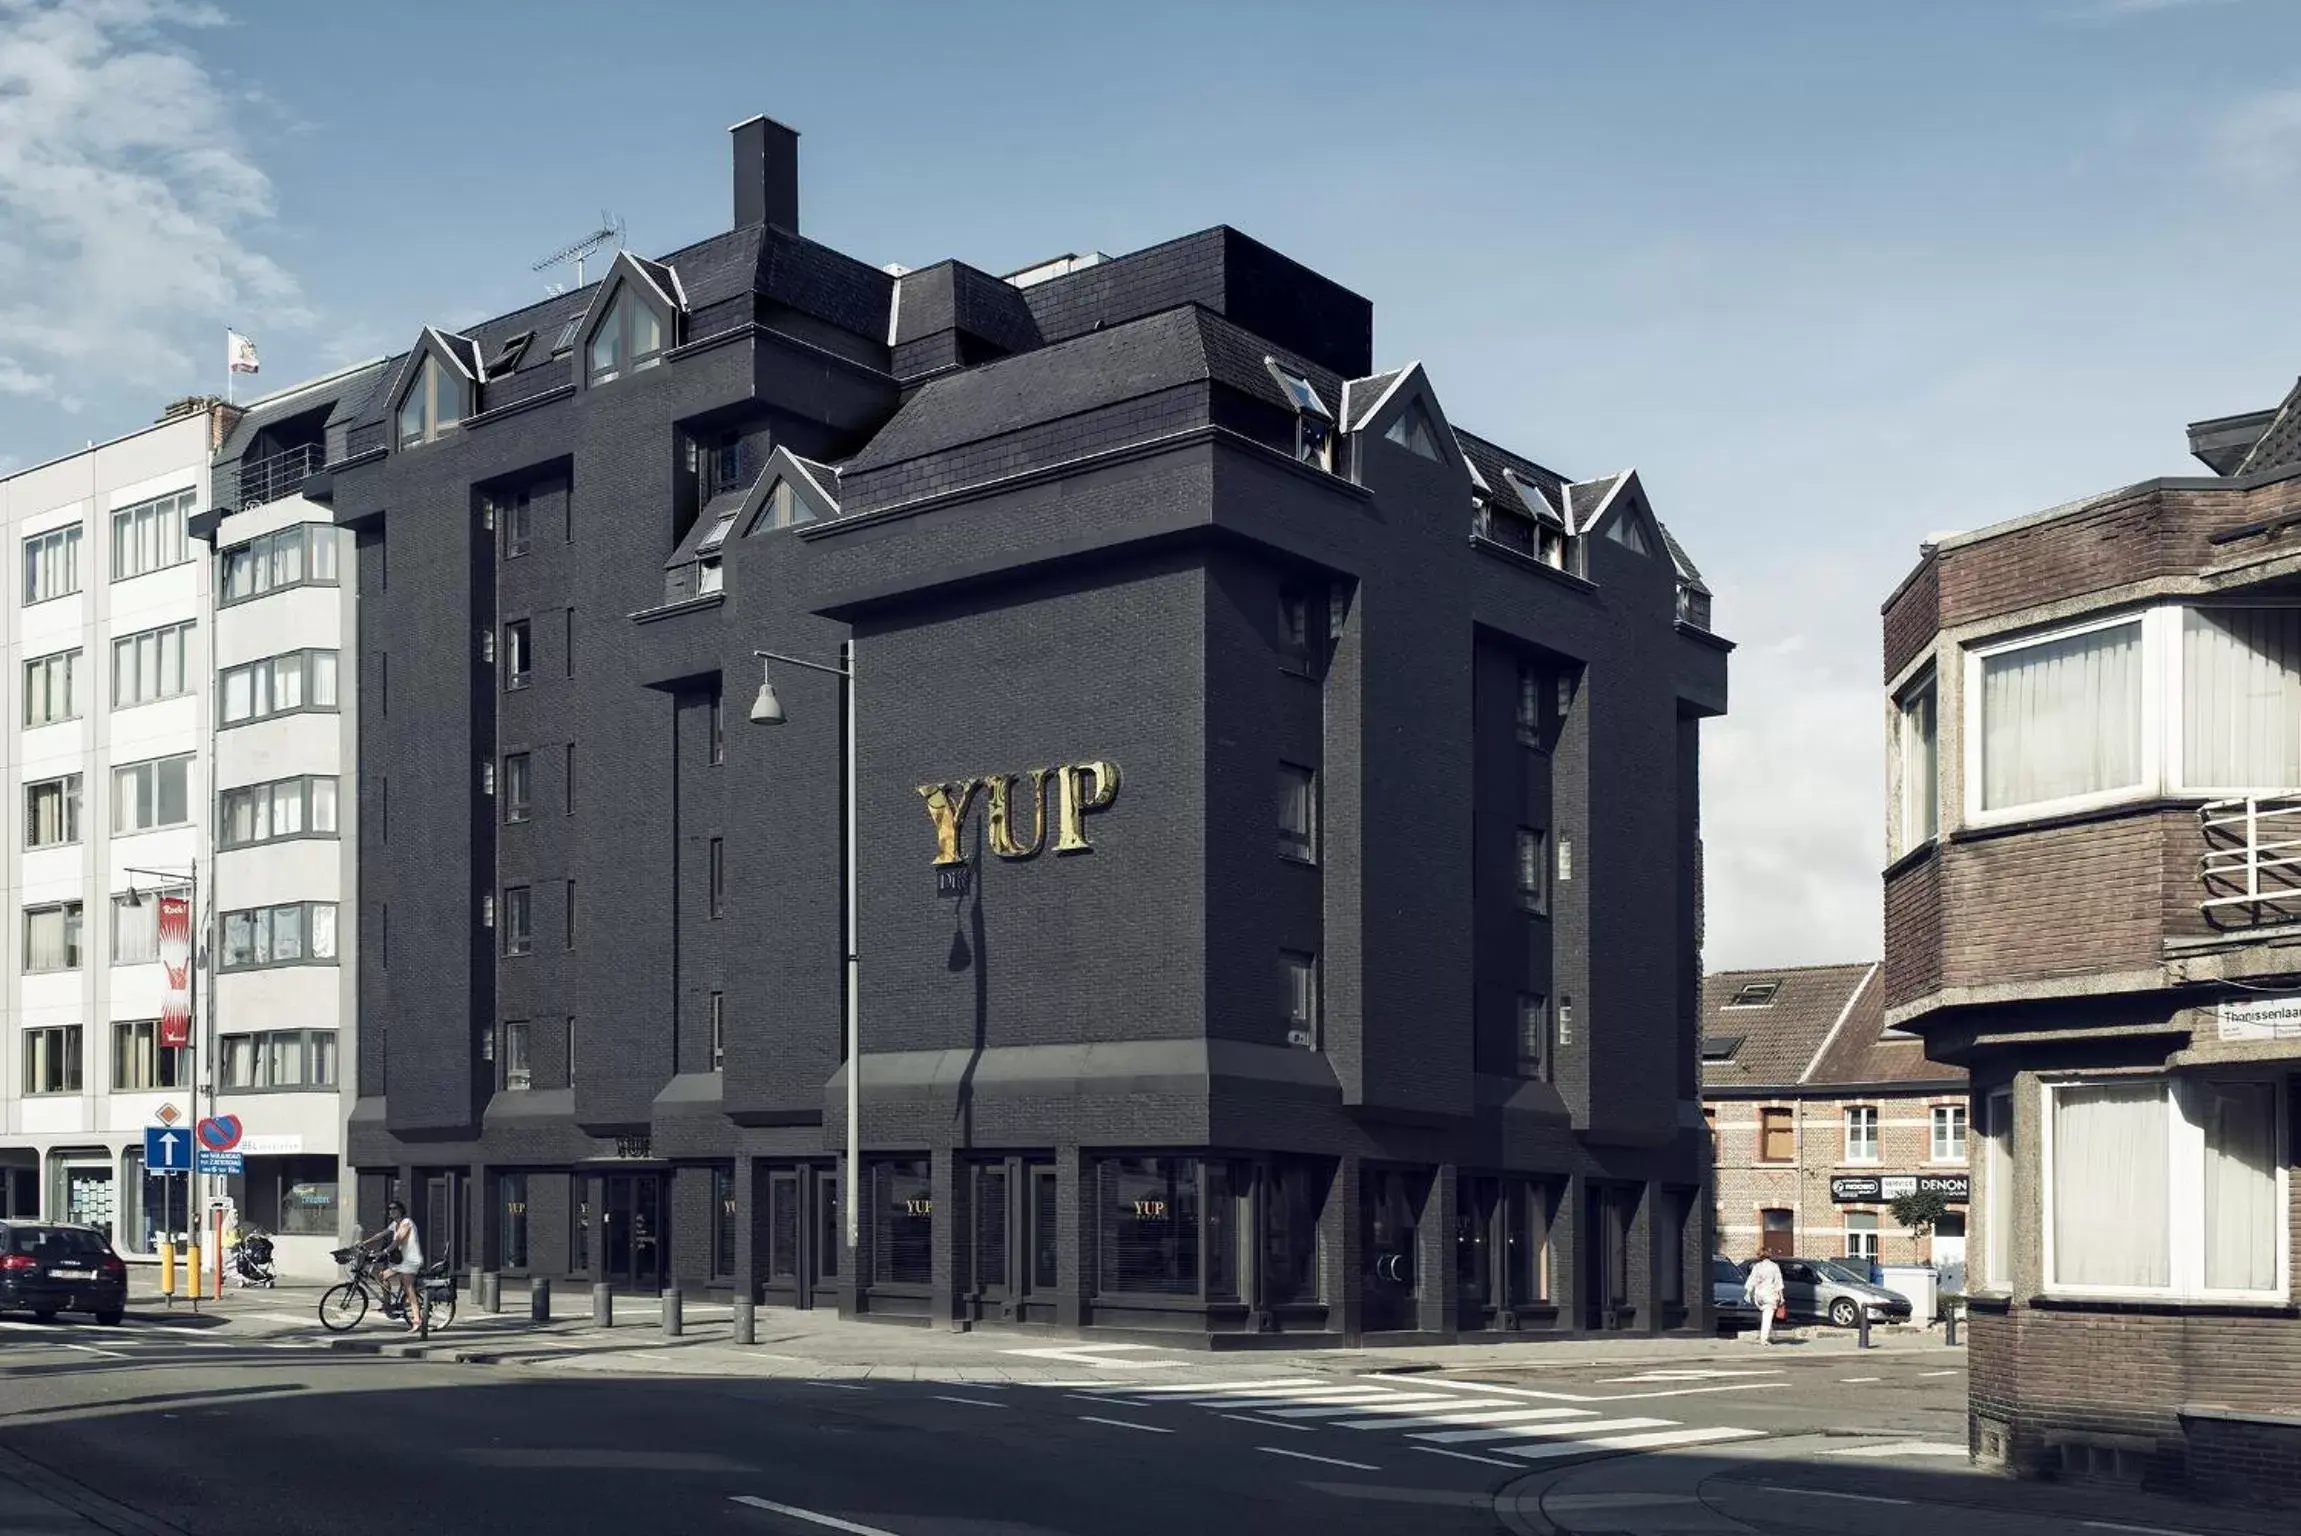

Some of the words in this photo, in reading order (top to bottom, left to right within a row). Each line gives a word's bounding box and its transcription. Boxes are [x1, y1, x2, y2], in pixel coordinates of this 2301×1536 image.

[915, 761, 1124, 865] YUP
[2223, 1006, 2301, 1023] Thonissenlaa
[1921, 1179, 1967, 1191] DENON
[1133, 1200, 1164, 1215] YUP
